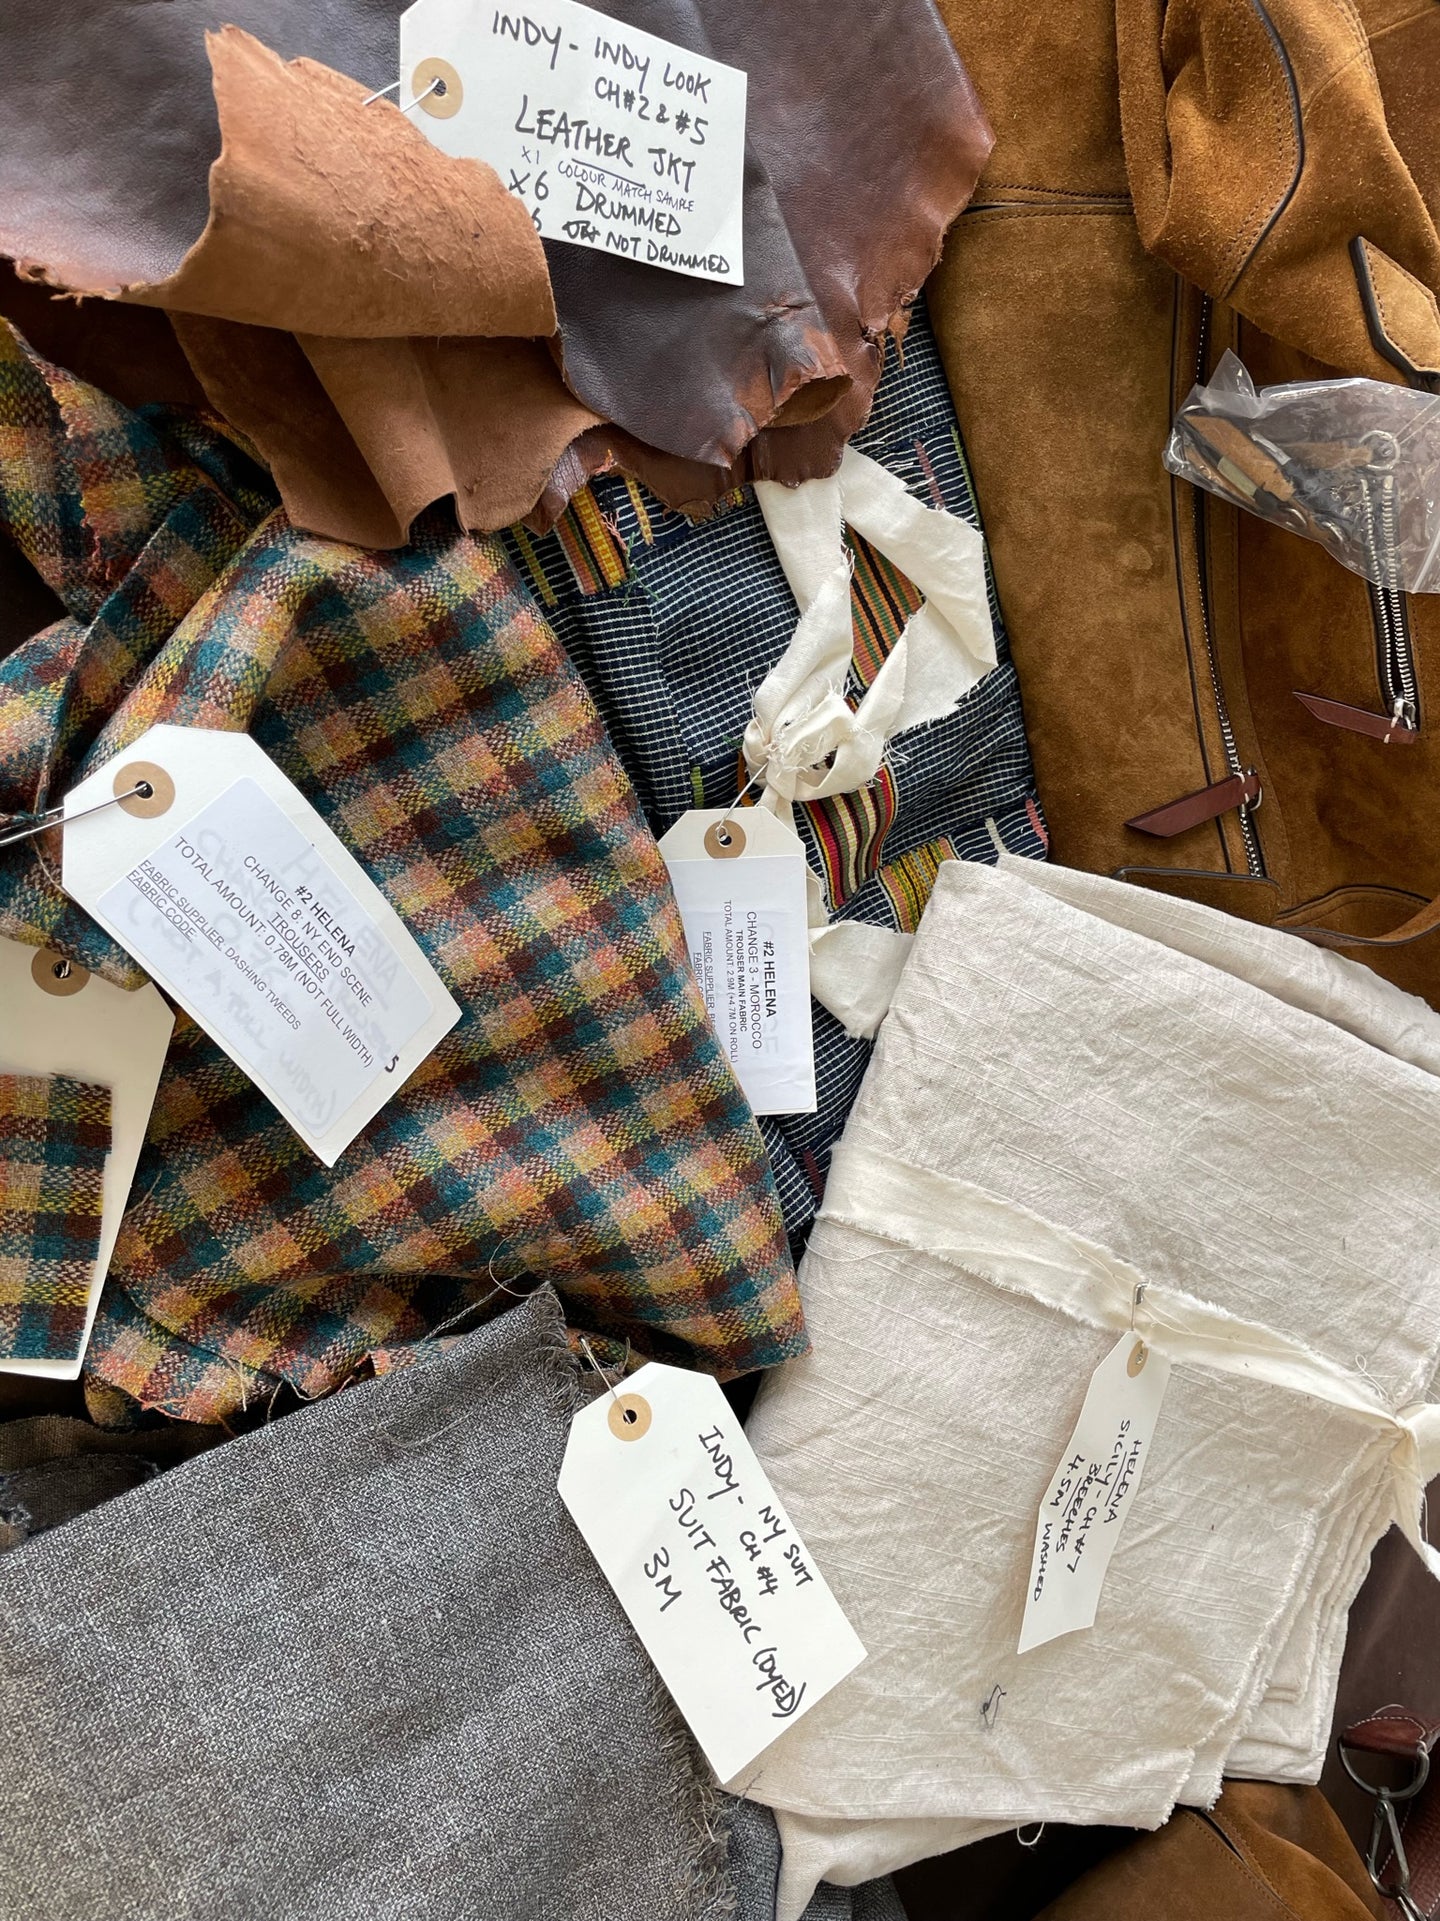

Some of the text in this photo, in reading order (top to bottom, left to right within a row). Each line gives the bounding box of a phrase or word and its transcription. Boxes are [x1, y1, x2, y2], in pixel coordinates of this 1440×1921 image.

[662, 62, 712, 104] LOOK
[655, 103, 670, 124] &
[514, 94, 697, 194] LEATHER JKT
[557, 160, 607, 188] COLOUR
[611, 181, 653, 204] MATCH
[655, 190, 695, 213] SAMPLE
[575, 181, 682, 238] DRUMMED
[605, 231, 642, 258] NOT
[646, 239, 730, 274] DRUMMED
[127, 869, 197, 944] FABRIC CODE:
[243, 855, 373, 1008] CHANGE 8: NY END SCENE
[294, 885, 356, 958] #2 HELENA
[723, 899, 733, 927] TOTAL
[140, 859, 179, 901] FABRIC
[176, 896, 226, 952] SUPPLIER:
[224, 946, 268, 992] DASHING
[265, 988, 302, 1030] TWEEDS
[174, 836, 213, 882] TOTAL
[210, 879, 267, 937] AMOUNT:
[264, 934, 299, 972] 0.78M
[294, 970, 325, 1000] (NOT
[320, 998, 344, 1030] FULL
[342, 1024, 374, 1068] WIDTH)
[271, 911, 330, 983] TROUSERS
[702, 931, 714, 966] FABRIC
[746, 911, 759, 964] CHANGE
[763, 941, 775, 957] #2
[693, 952, 704, 986] FABRIC
[726, 970, 735, 990] 2.9M
[735, 929, 748, 1032] TROUSER MAIN FABRIC
[748, 966, 759, 974] 3
[763, 961, 777, 1018] HELENA
[726, 992, 737, 1020] (+4.7M
[728, 1021, 737, 1036] ON
[749, 984, 763, 1050] MOROCCO
[728, 1037, 739, 1064] ROLL)
[1094, 1419, 1131, 1486] SICILY
[1055, 1463, 1102, 1553] BREECHES
[1103, 1439, 1143, 1524] HELENA
[758, 1505, 787, 1544] NY
[783, 1543, 814, 1587] SUIT
[1033, 1454, 1085, 1602] 4.5M WASHED
[668, 1488, 807, 1718] SUIT FABRIC (DYED)
